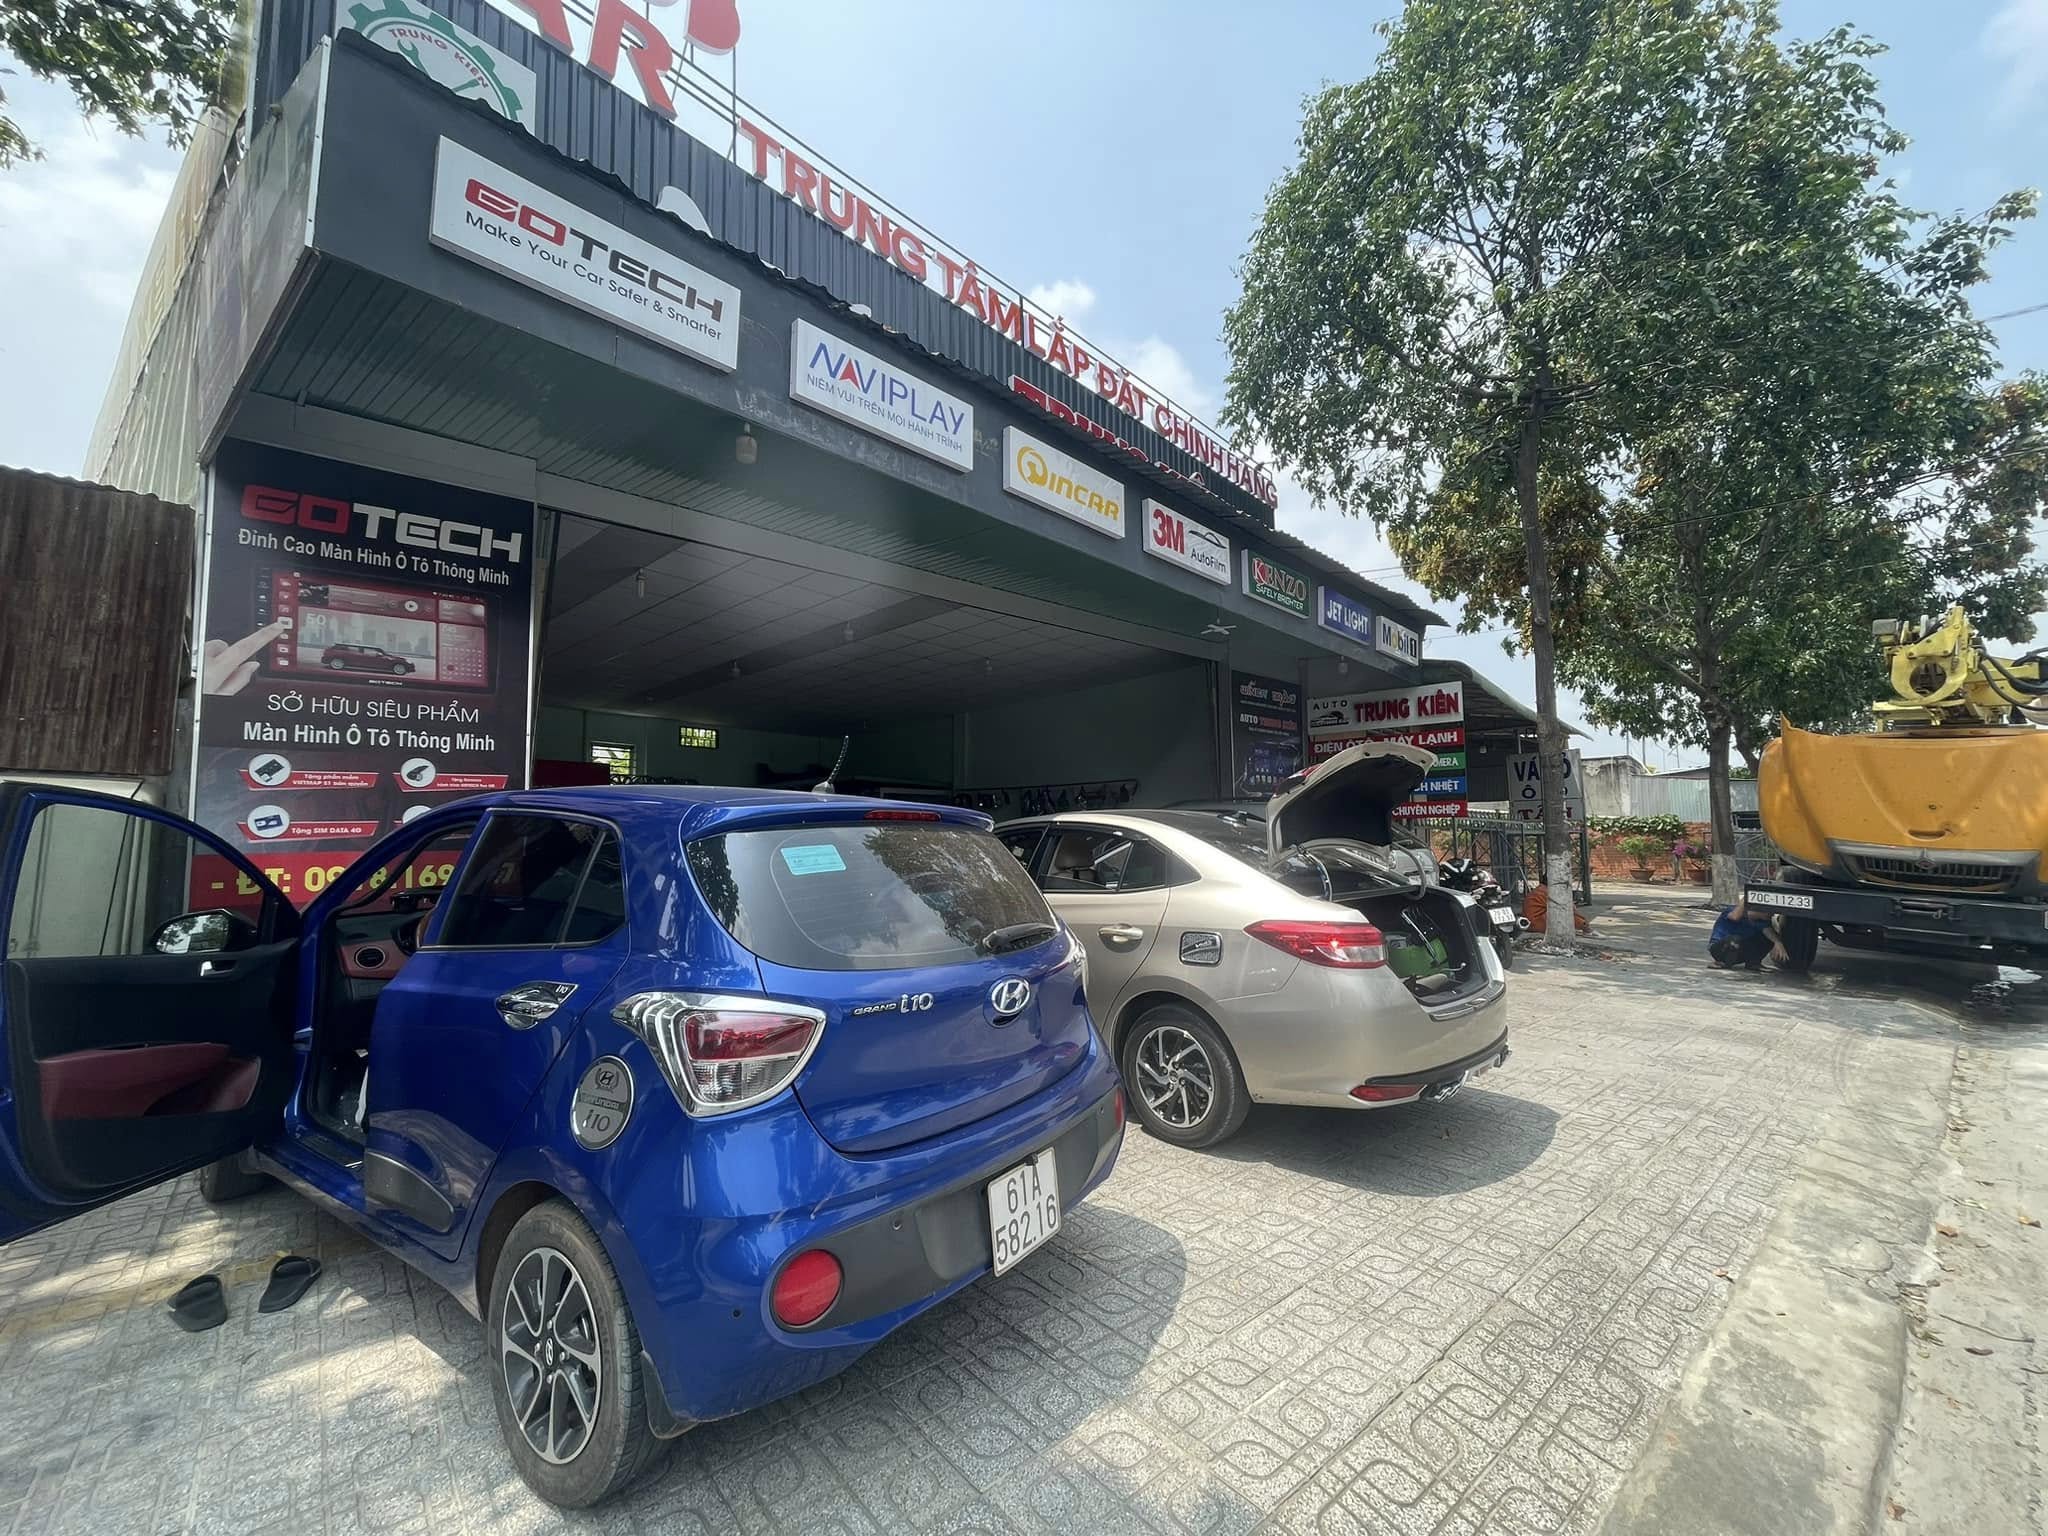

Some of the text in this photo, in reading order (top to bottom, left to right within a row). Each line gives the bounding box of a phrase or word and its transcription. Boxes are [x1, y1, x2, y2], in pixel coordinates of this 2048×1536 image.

[388, 28, 449, 50] TRUNG
[464, 178, 723, 323] GOTECH
[465, 210, 722, 341] Make Your Car Safer & Smarter
[738, 117, 927, 282] TRUNG
[933, 252, 1022, 341] TÂM
[1024, 315, 1090, 378] LẮP
[1097, 361, 1149, 421] ĐẶT
[1152, 403, 1225, 477] CHÍNH
[809, 342, 965, 435] NAVIPLAY
[837, 385, 855, 404] VUI
[859, 397, 885, 417] TRÊN
[240, 484, 523, 563] GOTECH
[1152, 508, 1185, 554] 3M
[239, 528, 510, 586] Đỉnh Cao Màn Hình Ô Tô Thông Minh
[1190, 547, 1226, 573] AutoFilm
[1252, 557, 1307, 601] KENZO
[1255, 583, 1304, 610] SAFELY BRIGHTER
[1327, 599, 1369, 635] JET LIGHT
[1382, 623, 1410, 656] Mobil
[267, 690, 479, 723] SỞ HỮU SIÊU PHẨM
[1313, 700, 1347, 710] AUTO
[1354, 689, 1459, 722] TRUNG KIÊN
[243, 721, 495, 753] Màn Hình Ô Tô Thông Minh
[1418, 731, 1457, 747] LẠNH
[1513, 755, 1541, 782] VÁ
[1430, 779, 1460, 793] NHIỆT
[1428, 802, 1461, 818] NGHIỆP
[853, 992, 934, 1015] GRAND i10
[583, 1108, 611, 1132] i10
[1006, 1163, 1042, 1214] 61A
[995, 1193, 1057, 1265] 582.16
